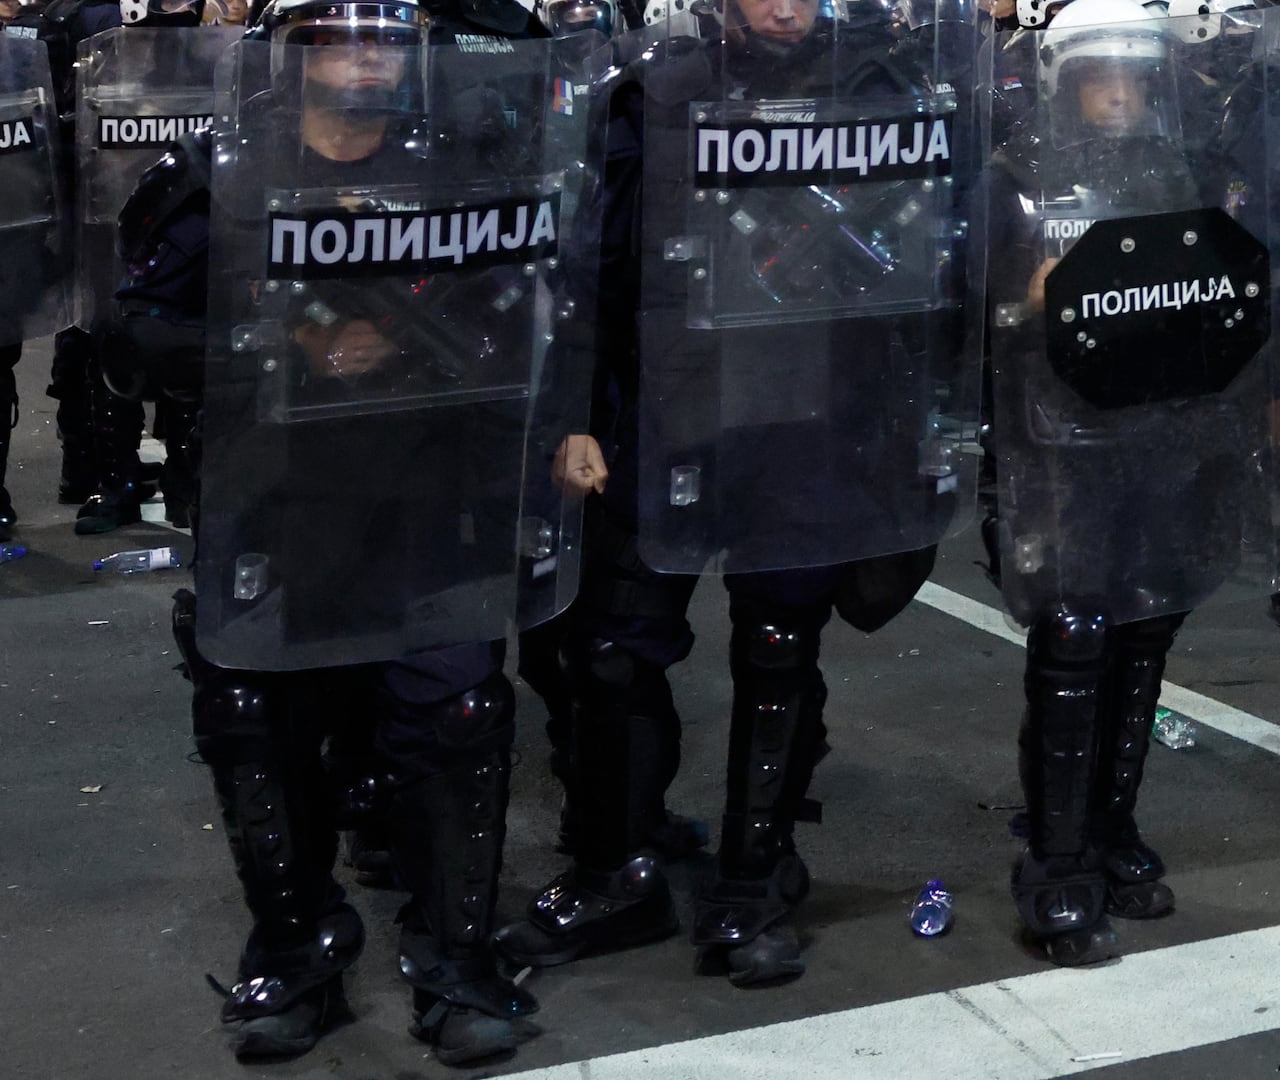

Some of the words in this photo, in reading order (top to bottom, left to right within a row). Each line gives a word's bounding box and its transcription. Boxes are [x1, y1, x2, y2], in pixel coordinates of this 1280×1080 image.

[698, 119, 950, 175] ПОЛИЦИЈА
[271, 204, 556, 265] ПОЛИЦИЈА
[1082, 275, 1236, 319] ПОЛИЦИЈА
